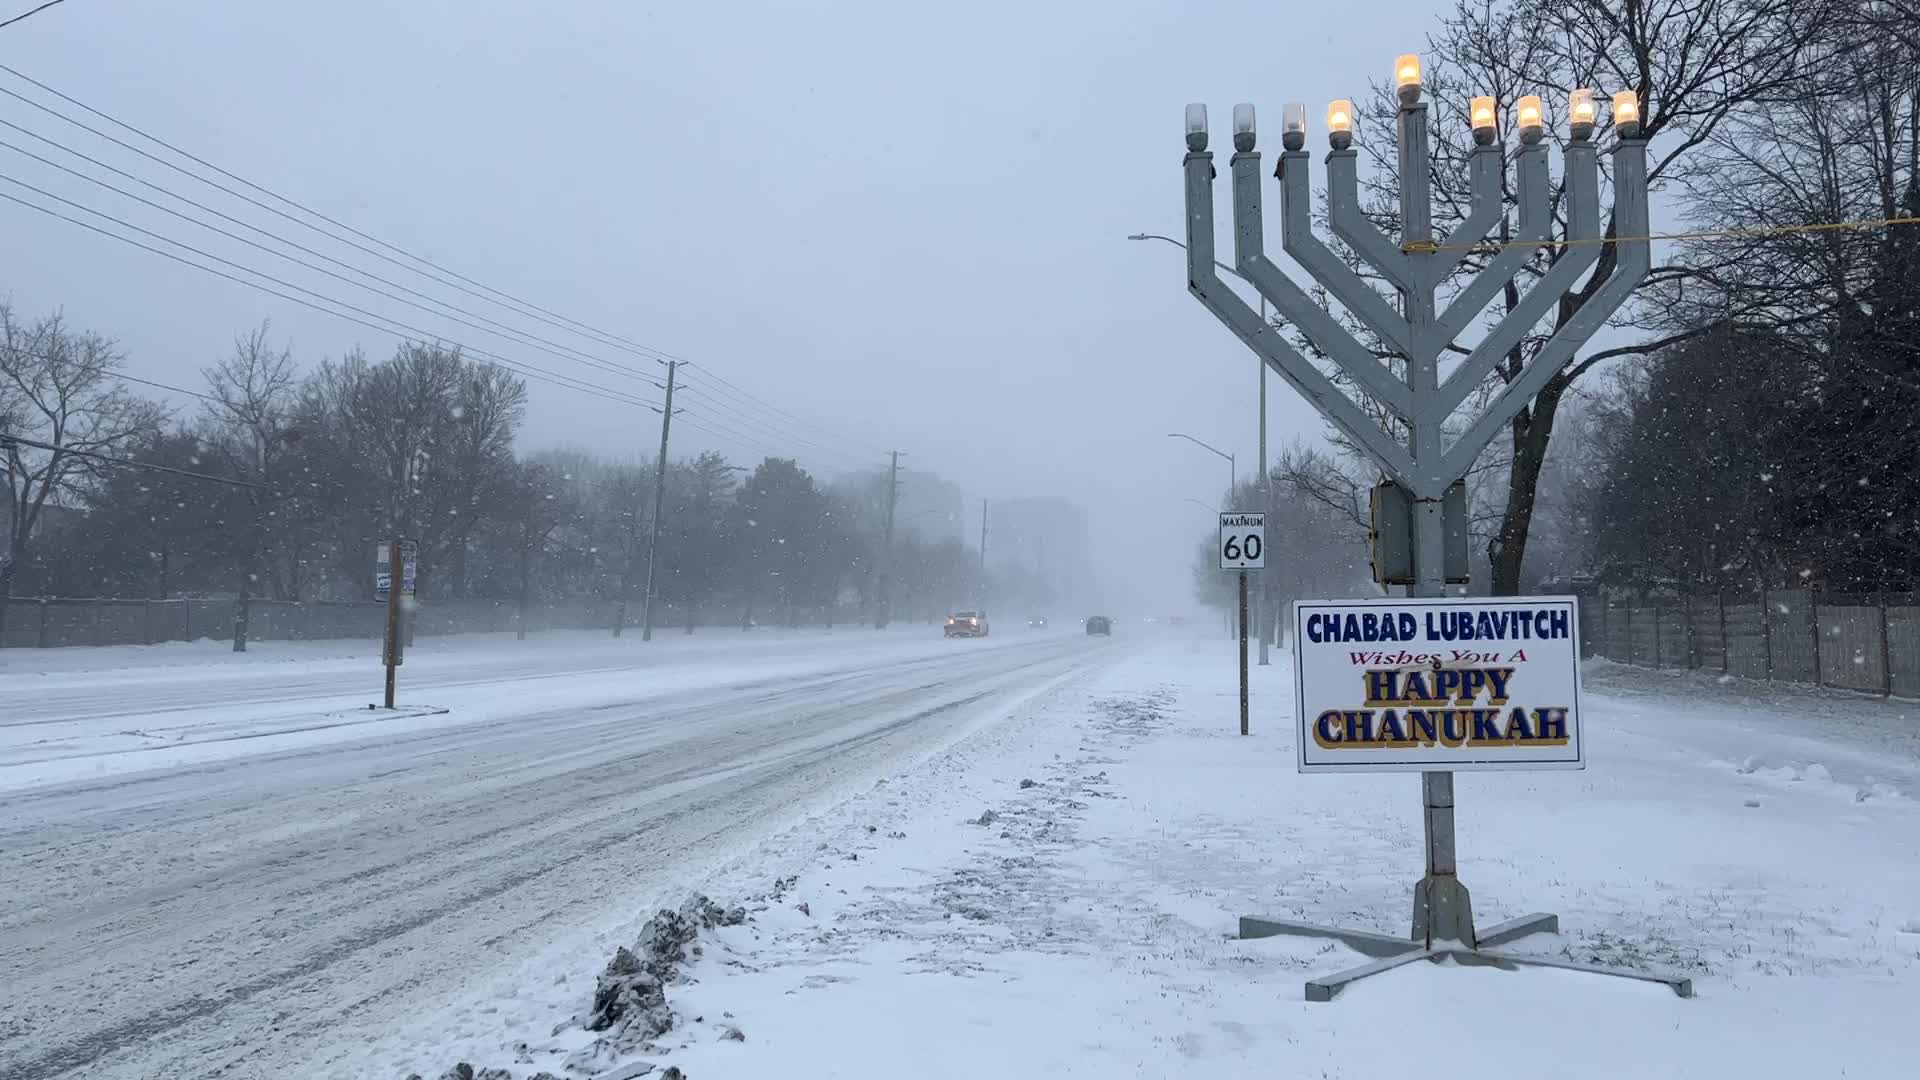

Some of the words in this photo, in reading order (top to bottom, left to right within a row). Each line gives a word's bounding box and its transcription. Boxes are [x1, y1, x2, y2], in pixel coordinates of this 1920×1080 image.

[1222, 516, 1264, 527] MAXIMUM
[1224, 534, 1262, 560] 60
[1307, 612, 1417, 643] CHABAD
[1426, 610, 1569, 641] LUBAVITCH
[1350, 650, 1442, 666] Wishes
[1451, 649, 1500, 664] You
[1508, 649, 1529, 662] A
[1362, 668, 1515, 707] HAPPY
[1312, 707, 1570, 749] CHANUKAH
